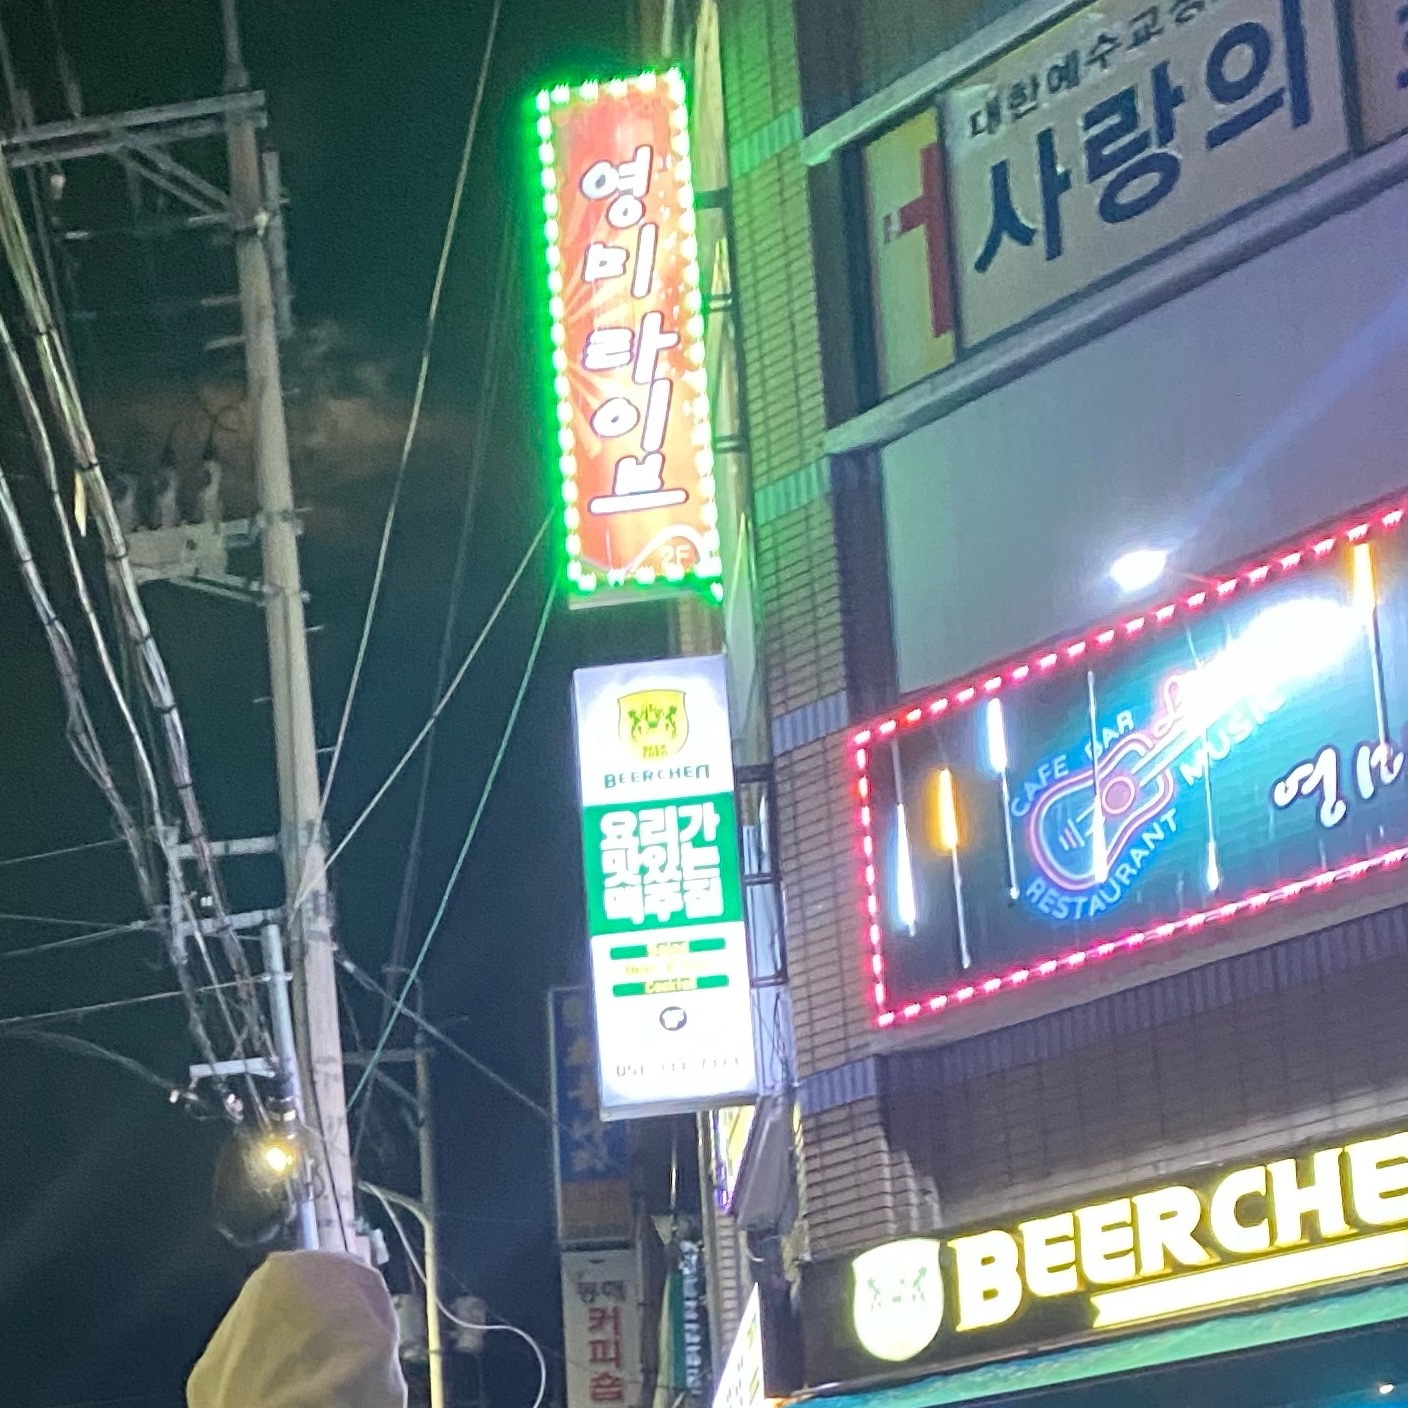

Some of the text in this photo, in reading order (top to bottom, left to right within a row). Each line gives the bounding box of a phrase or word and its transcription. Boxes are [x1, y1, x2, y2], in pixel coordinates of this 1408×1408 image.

[974, 0, 1311, 273] 사랑의
[580, 145, 688, 516] 영미라이브
[1010, 710, 1135, 818] CAFE BAR
[600, 802, 720, 850] 요리가
[601, 841, 721, 888] 맛있는
[1026, 808, 1177, 919] RESTAURANT
